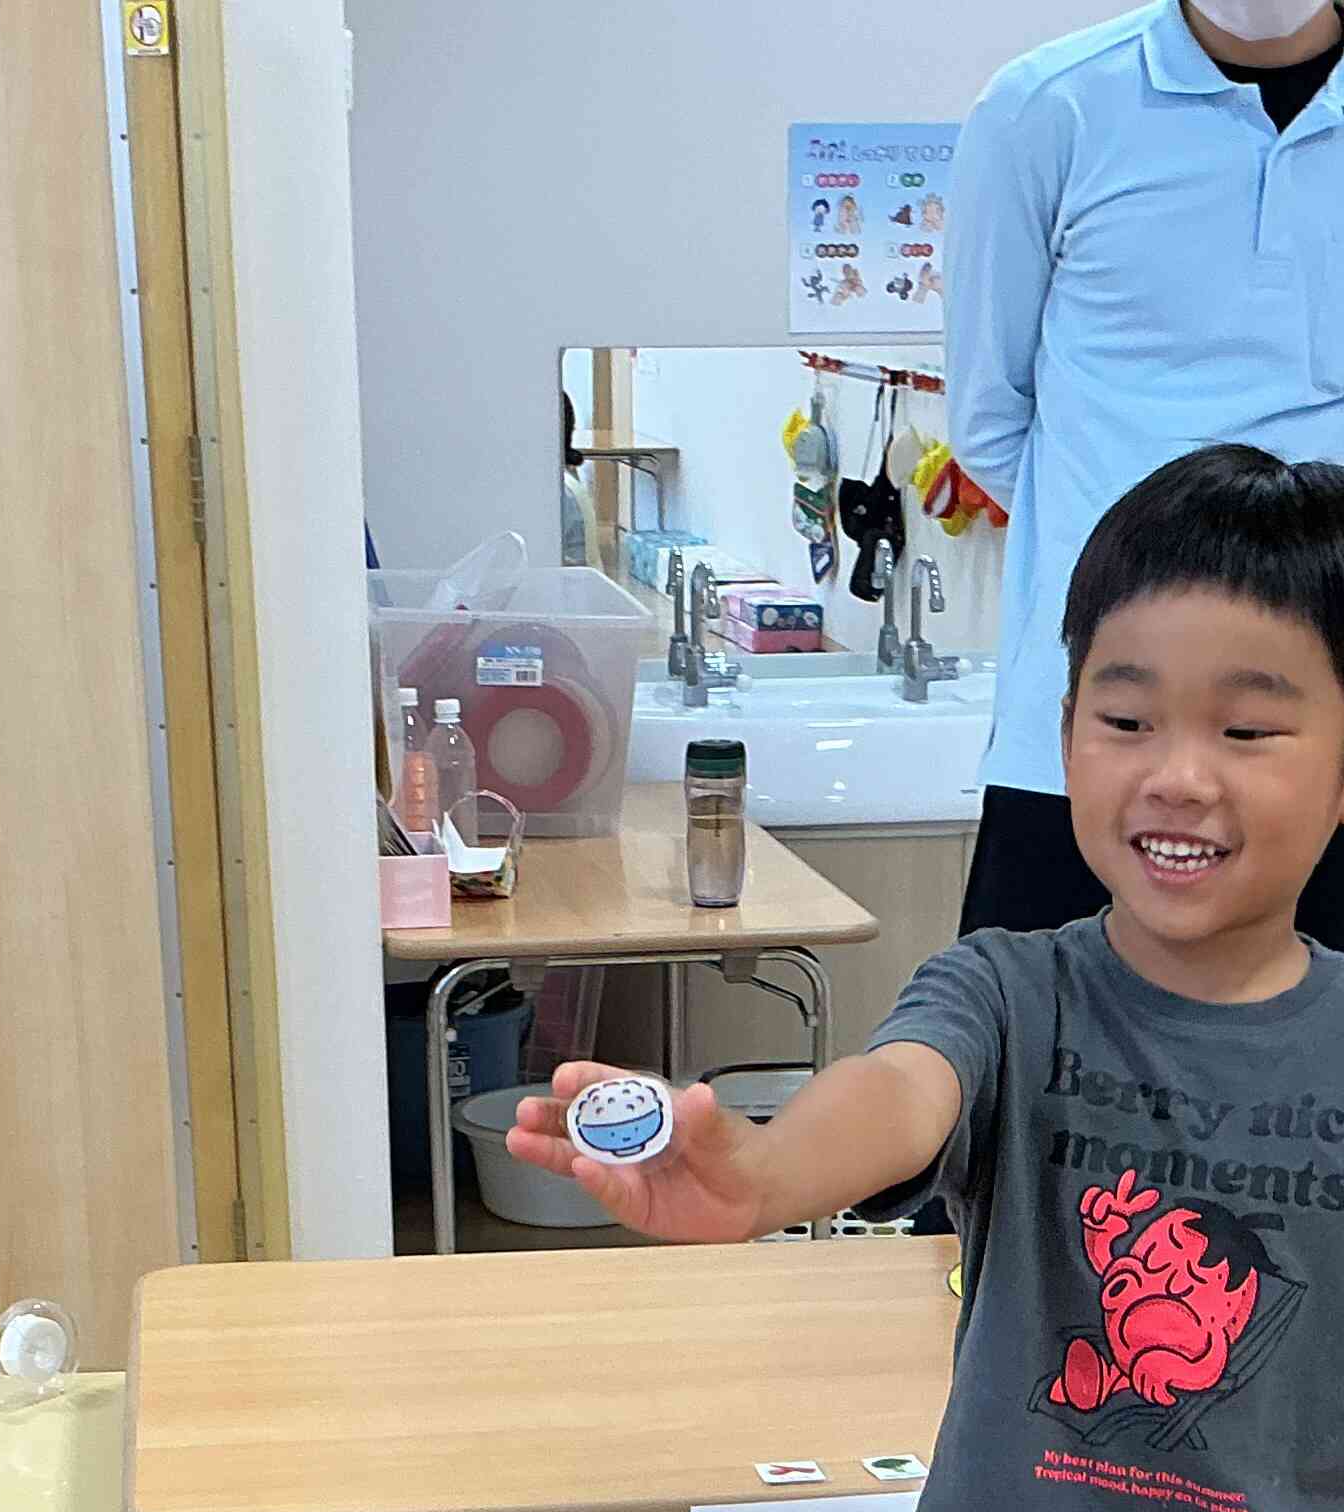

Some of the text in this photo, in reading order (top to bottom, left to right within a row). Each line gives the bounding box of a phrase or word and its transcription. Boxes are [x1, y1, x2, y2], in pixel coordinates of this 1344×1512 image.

[1044, 1048, 1235, 1140] Berry
[1034, 1466, 1087, 1482] Tropical
[1131, 1482, 1175, 1500] happy
[1063, 1454, 1093, 1468] best
[1096, 1459, 1126, 1476] plan
[1129, 1466, 1153, 1480] for
[1155, 1471, 1183, 1486] this
